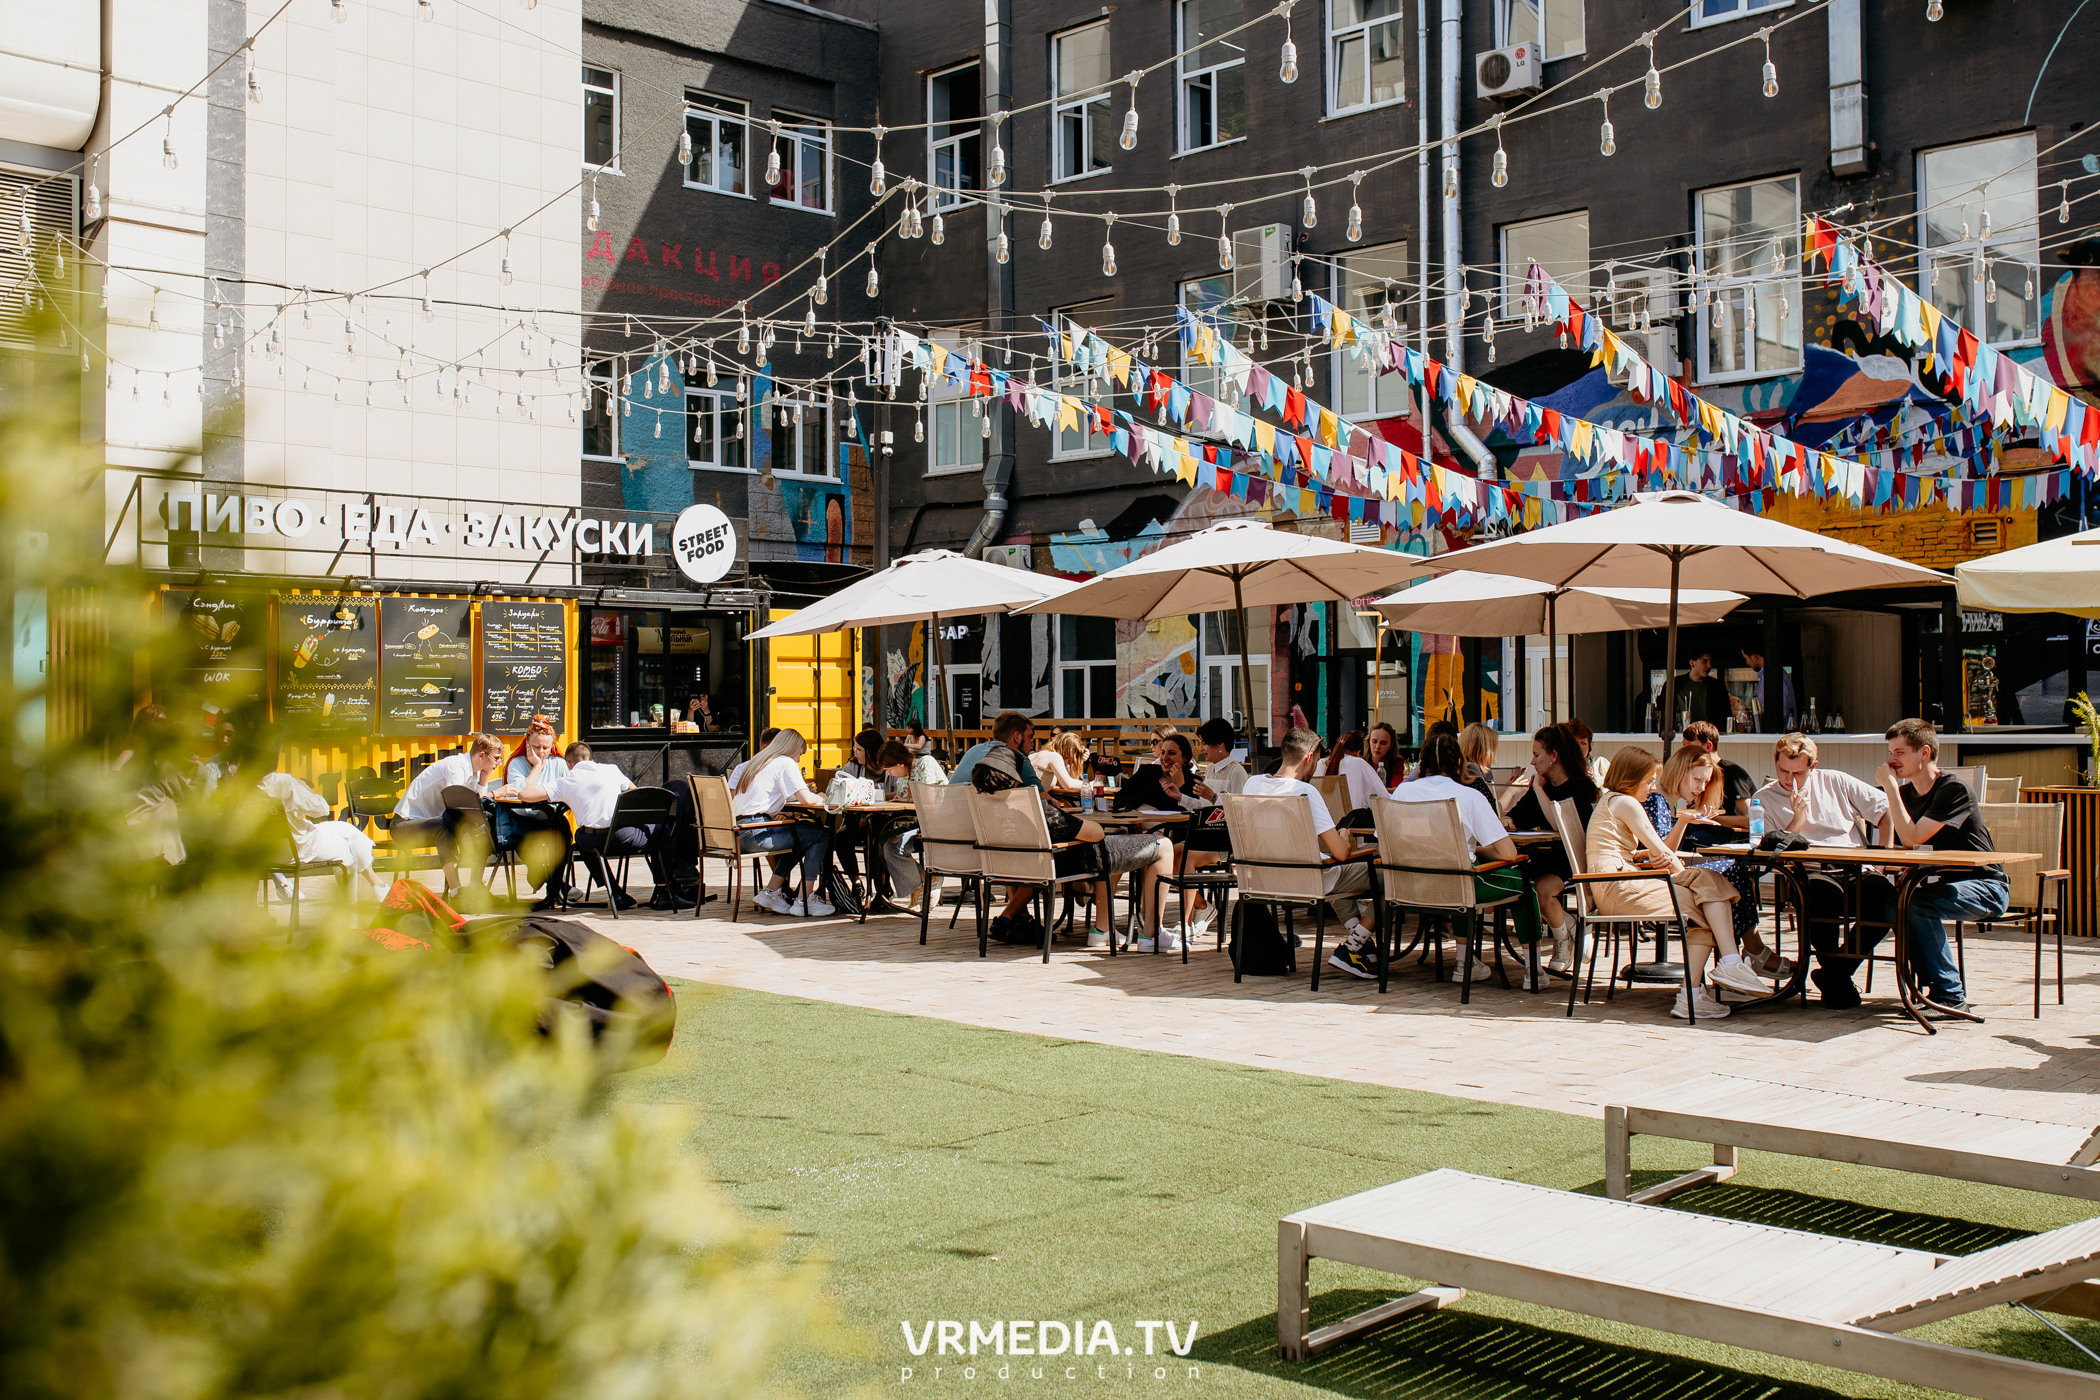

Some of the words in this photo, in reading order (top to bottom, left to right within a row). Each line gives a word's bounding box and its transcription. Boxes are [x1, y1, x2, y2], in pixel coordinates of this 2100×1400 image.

[650, 286, 754, 313] пространсто
[168, 492, 313, 538] ПИВО
[342, 503, 440, 550] ЕДА
[464, 511, 654, 557] ЗАКУСКИ
[679, 523, 729, 552] STREET
[687, 539, 725, 563] FOOD
[306, 614, 353, 629] Буррито
[508, 608, 540, 620] Закуски
[204, 672, 231, 683] WOK
[511, 665, 542, 674] КОМБО
